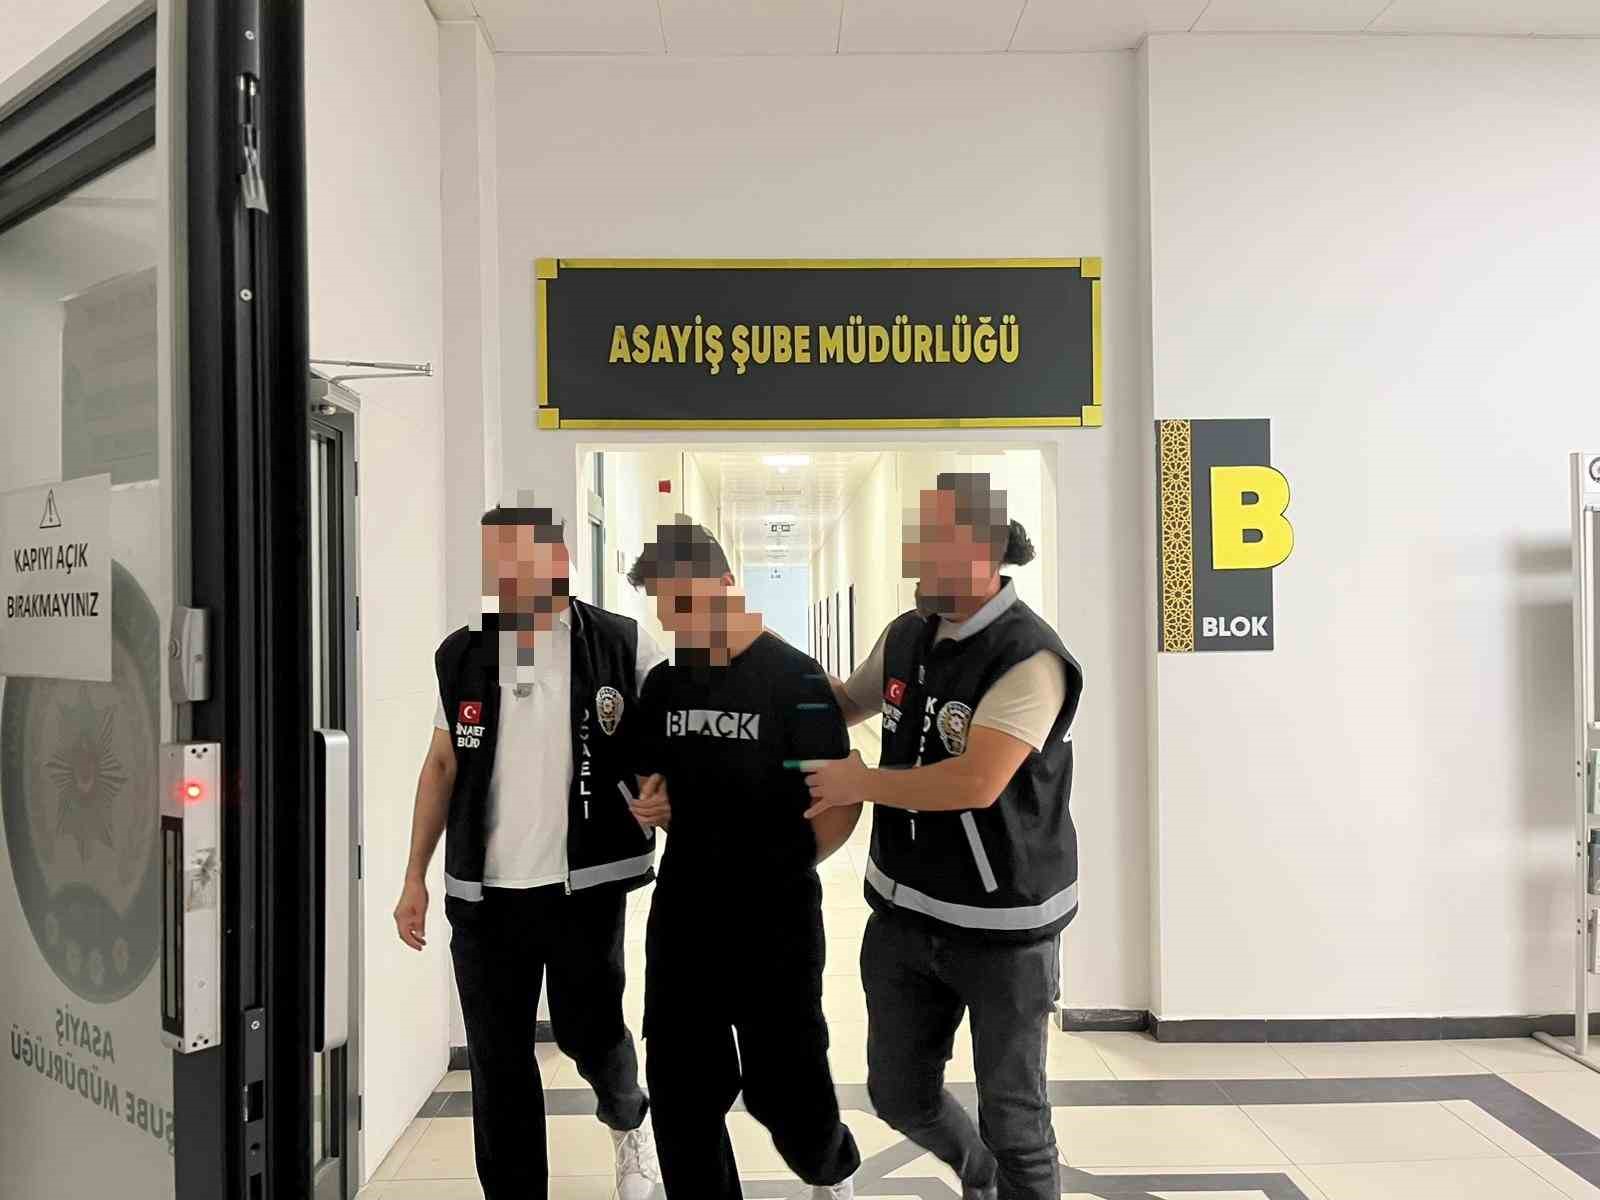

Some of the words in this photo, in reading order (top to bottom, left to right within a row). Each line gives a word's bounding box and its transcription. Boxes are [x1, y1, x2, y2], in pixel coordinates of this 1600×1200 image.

[608, 315, 724, 375] ASAYİŞ
[731, 324, 811, 375] ŞUBE
[819, 314, 1020, 363] MÜDÜRLÜĞÜ
[1210, 466, 1294, 570] B
[14, 546, 53, 573] KAPIYI
[56, 543, 89, 575] AÇIK
[7, 592, 99, 618] BIRAKMAYINIZ
[1202, 616, 1269, 637] BLOK
[666, 709, 761, 740] BLACK
